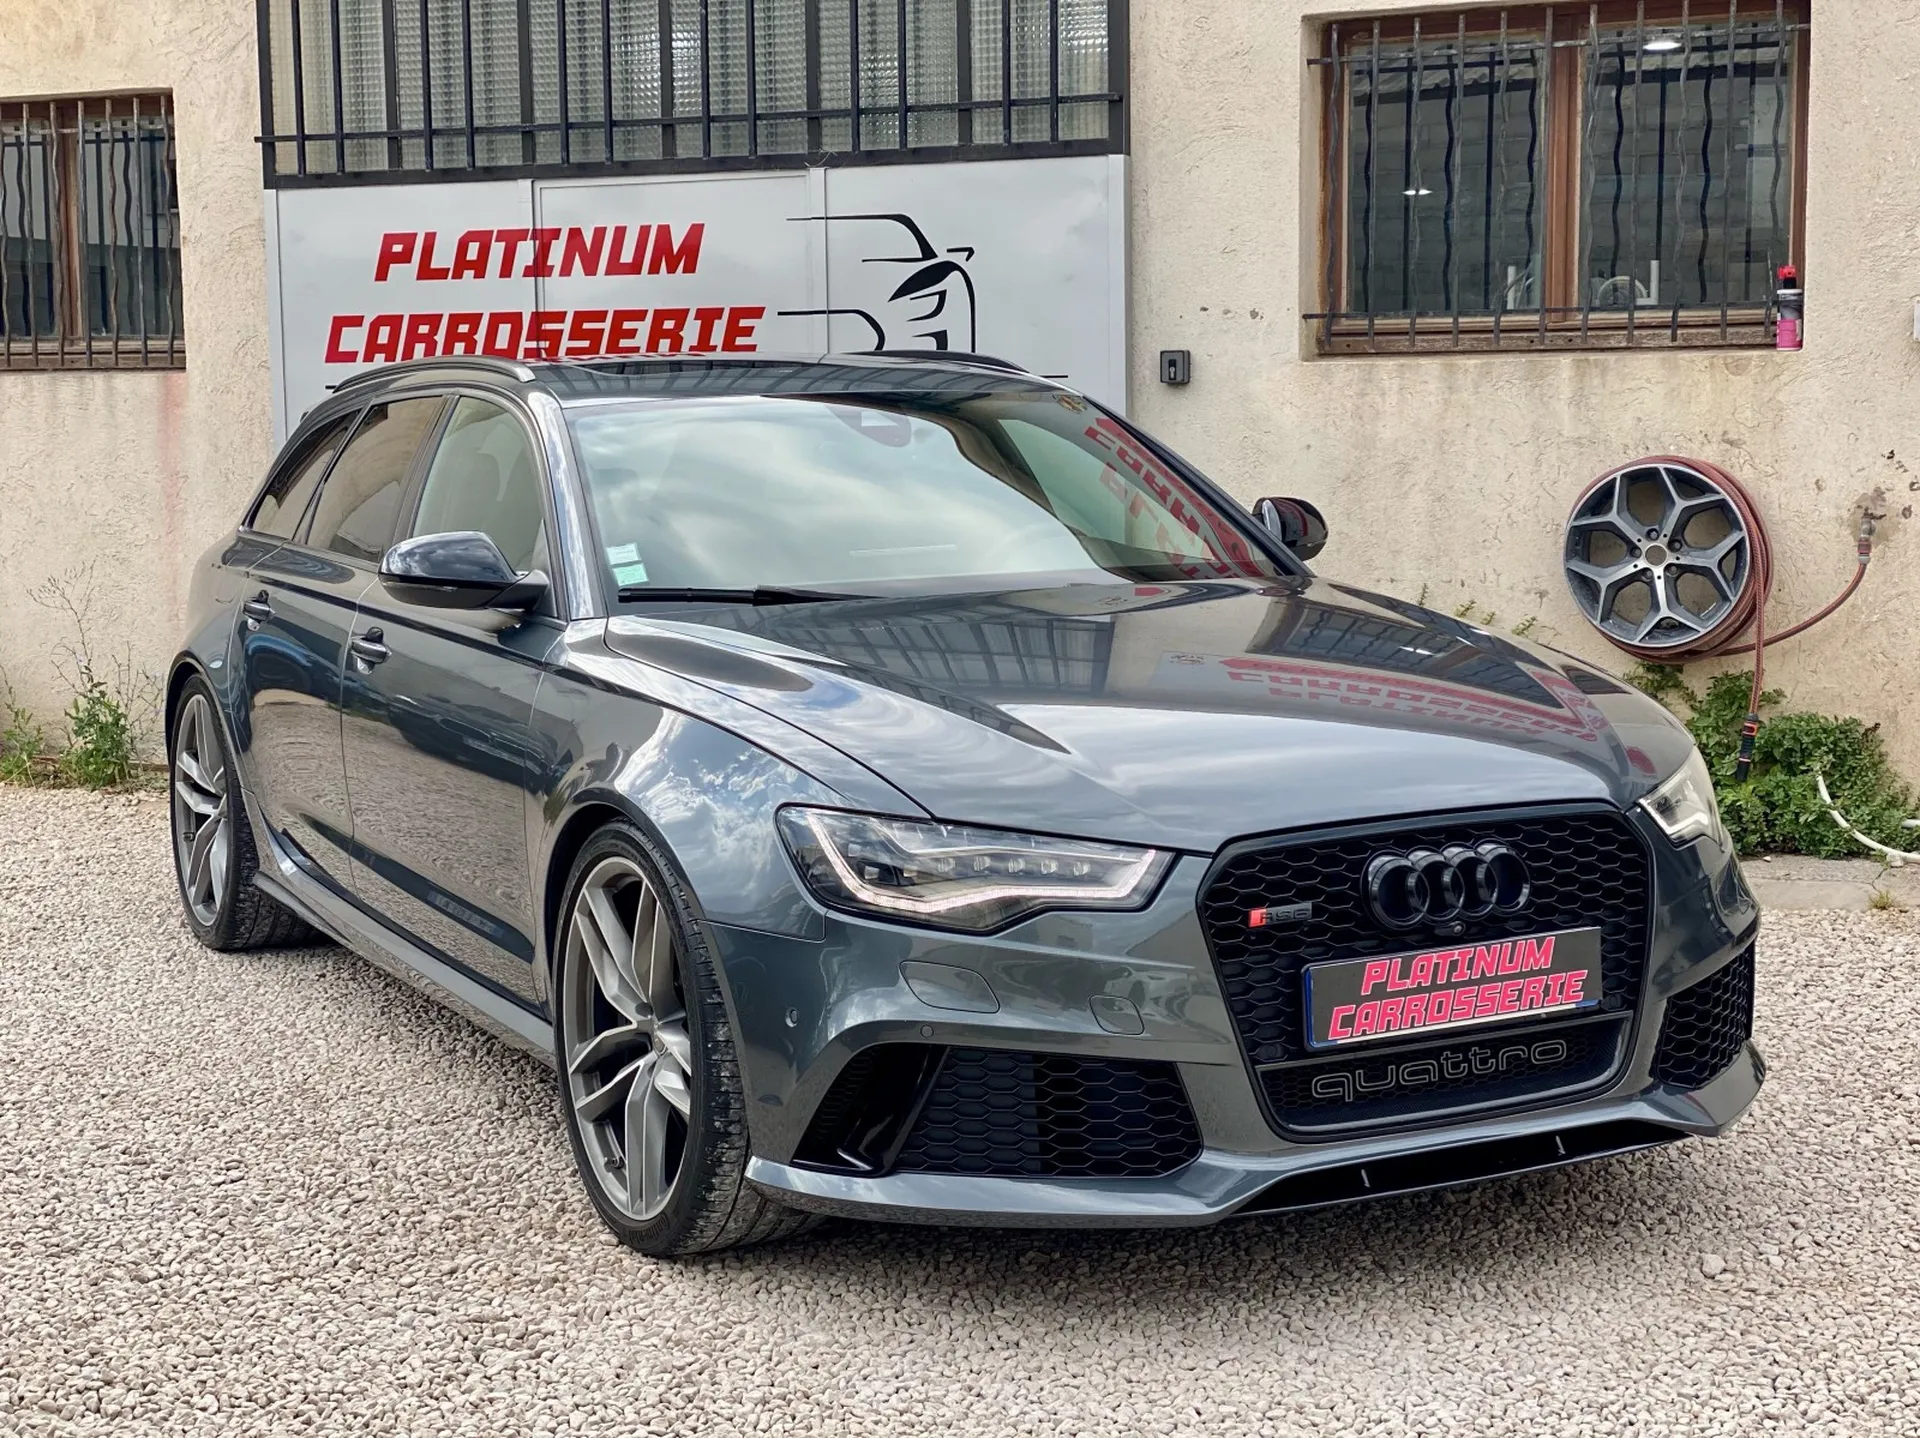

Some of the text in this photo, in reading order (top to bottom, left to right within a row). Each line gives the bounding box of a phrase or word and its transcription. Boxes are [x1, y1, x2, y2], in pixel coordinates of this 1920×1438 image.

[375, 224, 705, 282] PLATINUM
[324, 306, 766, 363] CARROSSERIE
[1250, 901, 1312, 926] RS6
[1362, 937, 1554, 995] PLATINUM
[1328, 970, 1588, 1040] CARROSSERIE
[1312, 1040, 1567, 1102] quattro
